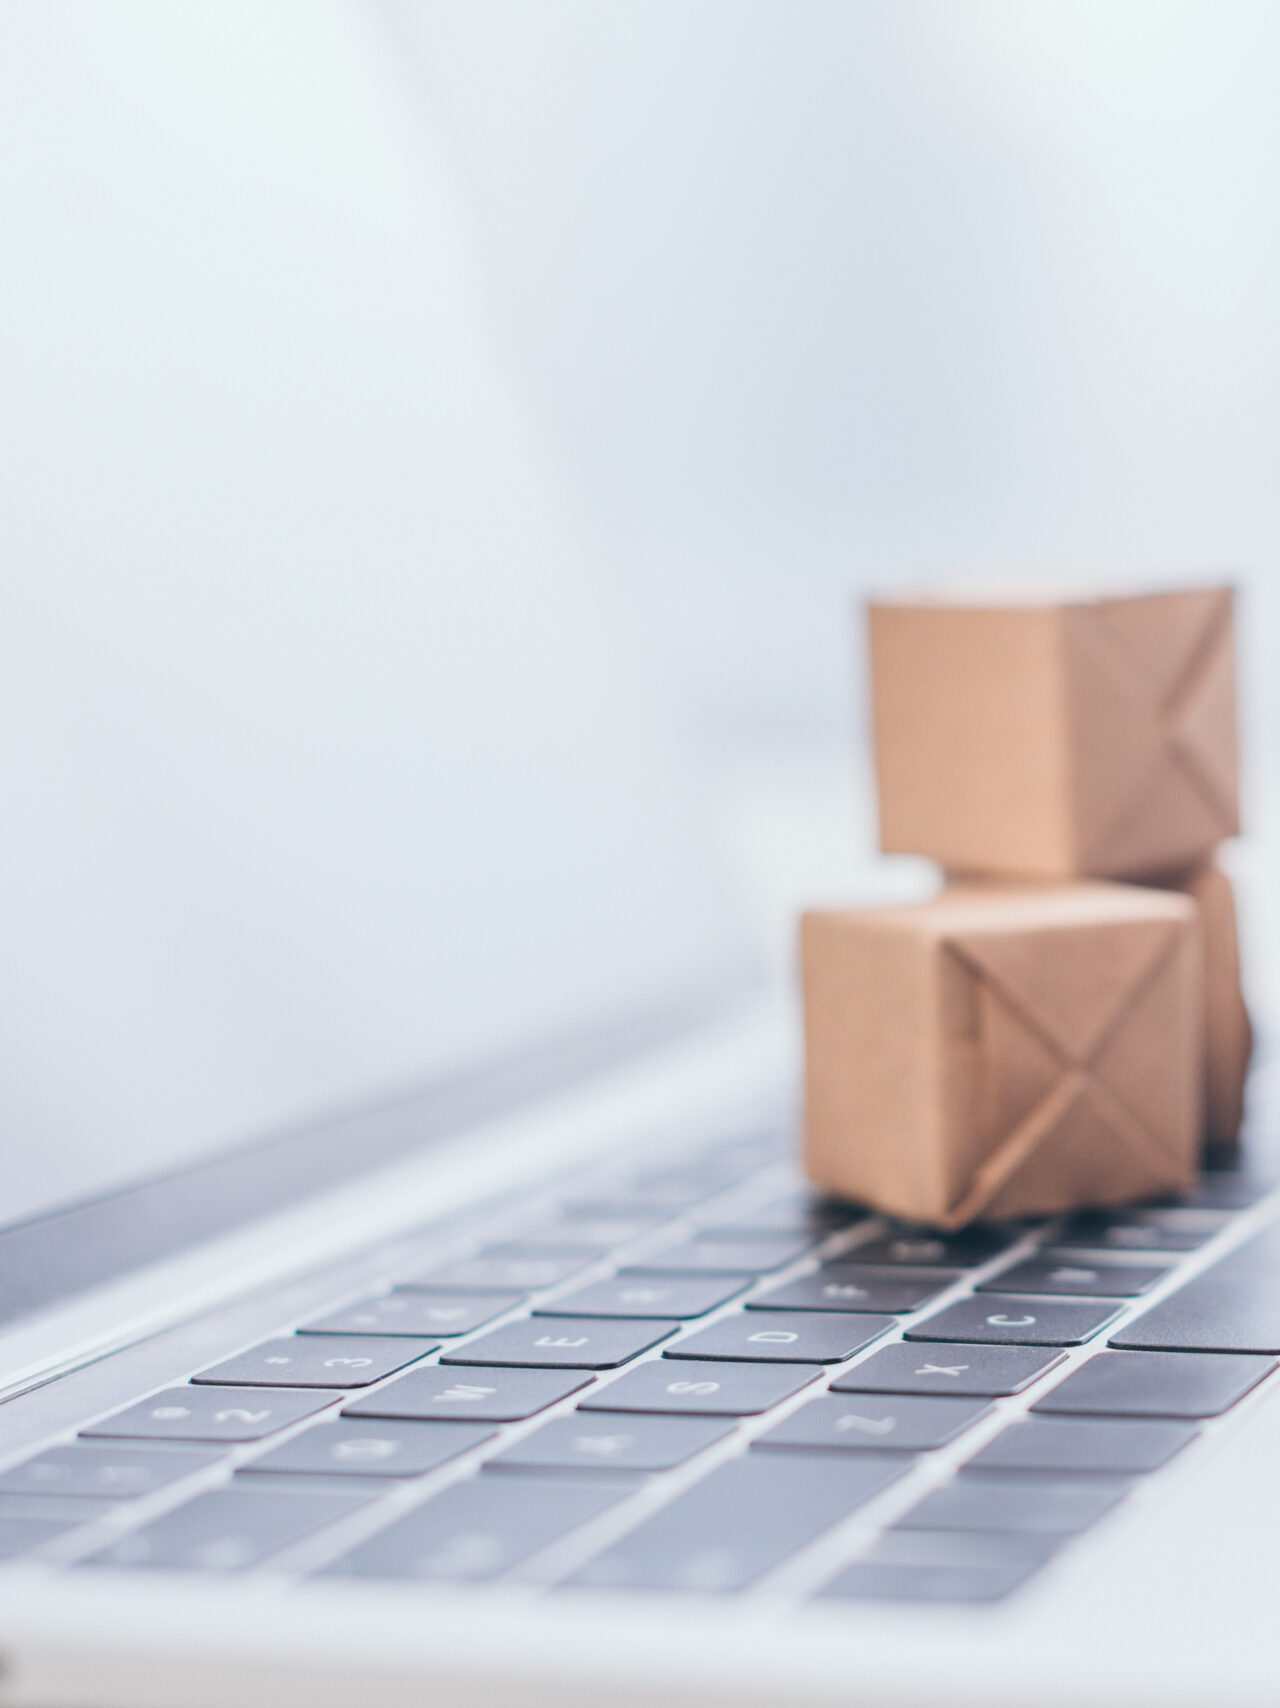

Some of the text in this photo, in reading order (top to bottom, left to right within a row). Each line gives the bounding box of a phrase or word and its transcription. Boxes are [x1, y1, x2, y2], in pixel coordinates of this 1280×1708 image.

[986, 1314, 1036, 1326] C
[533, 1336, 589, 1347] E
[747, 1331, 798, 1343] D
[323, 1357, 373, 1368] 3
[914, 1363, 969, 1377] X
[432, 1384, 497, 1401] W
[665, 1381, 720, 1396] S
[212, 1407, 273, 1425] 2
[834, 1414, 898, 1435] Z
